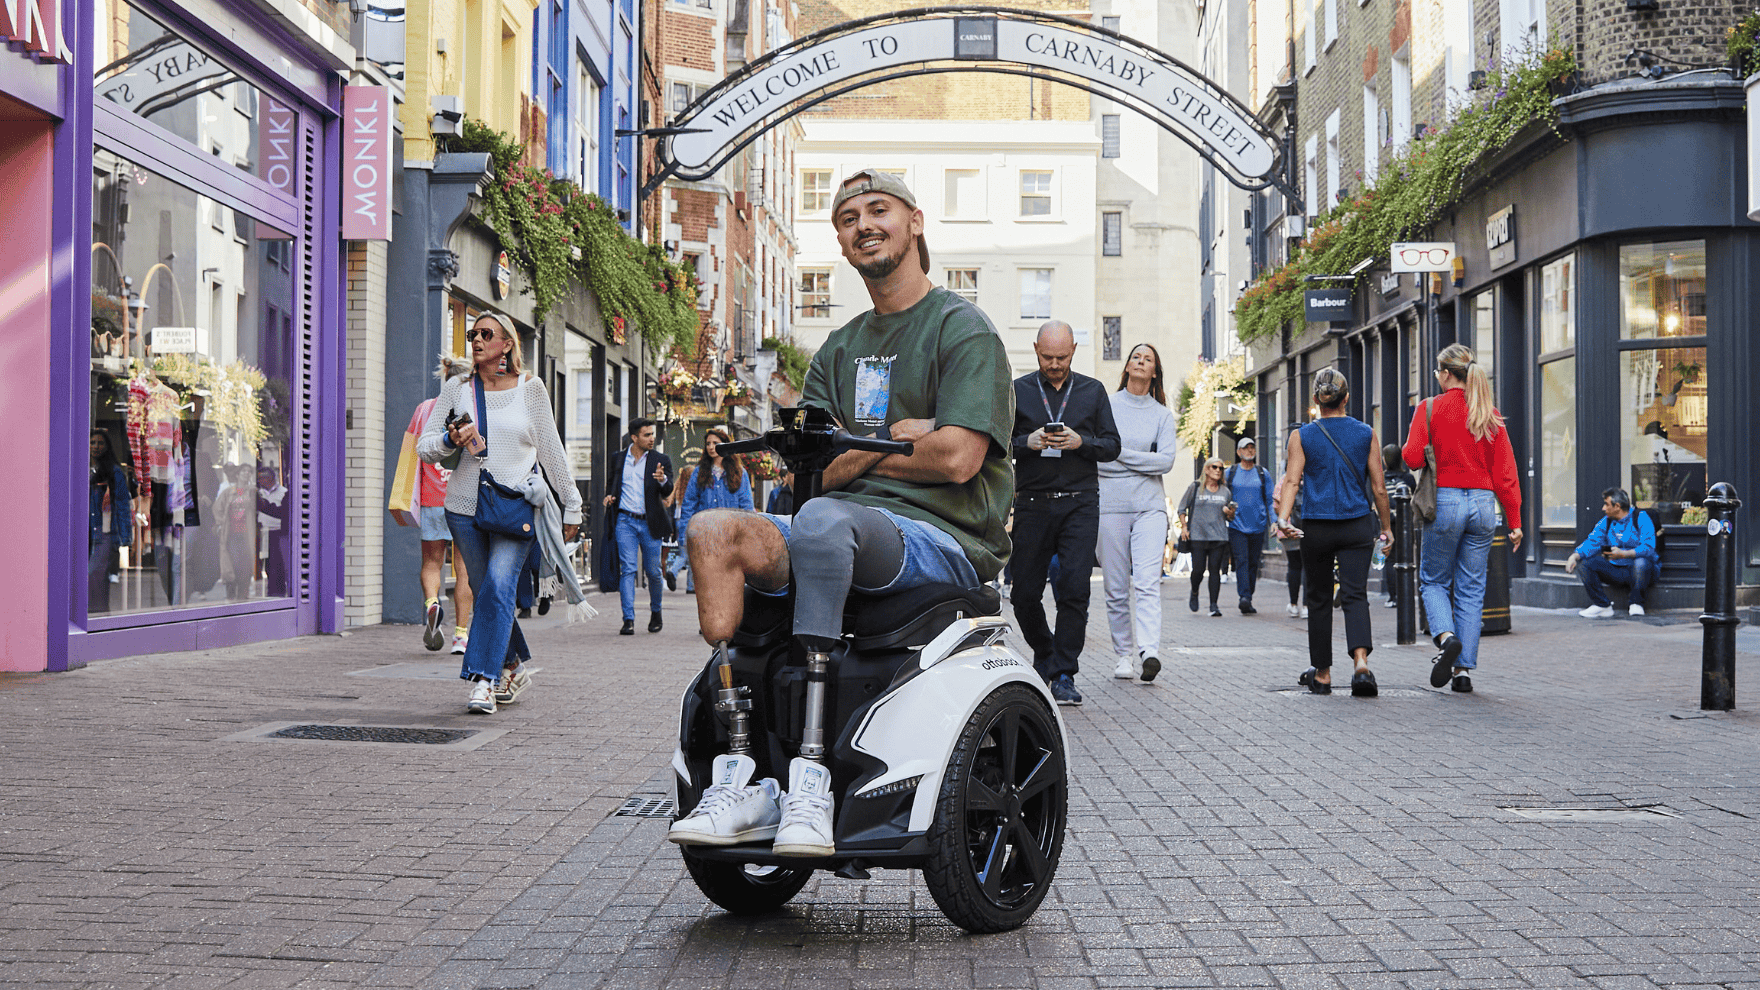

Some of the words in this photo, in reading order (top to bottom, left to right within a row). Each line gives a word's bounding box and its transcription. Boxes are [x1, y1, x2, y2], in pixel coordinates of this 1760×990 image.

[711, 50, 841, 128] WELCOME
[863, 35, 899, 59] TO
[1025, 33, 1155, 88] CARNABY
[1166, 86, 1256, 158] STREET
[353, 99, 378, 226] MONKI
[1310, 298, 1346, 307] Barbour
